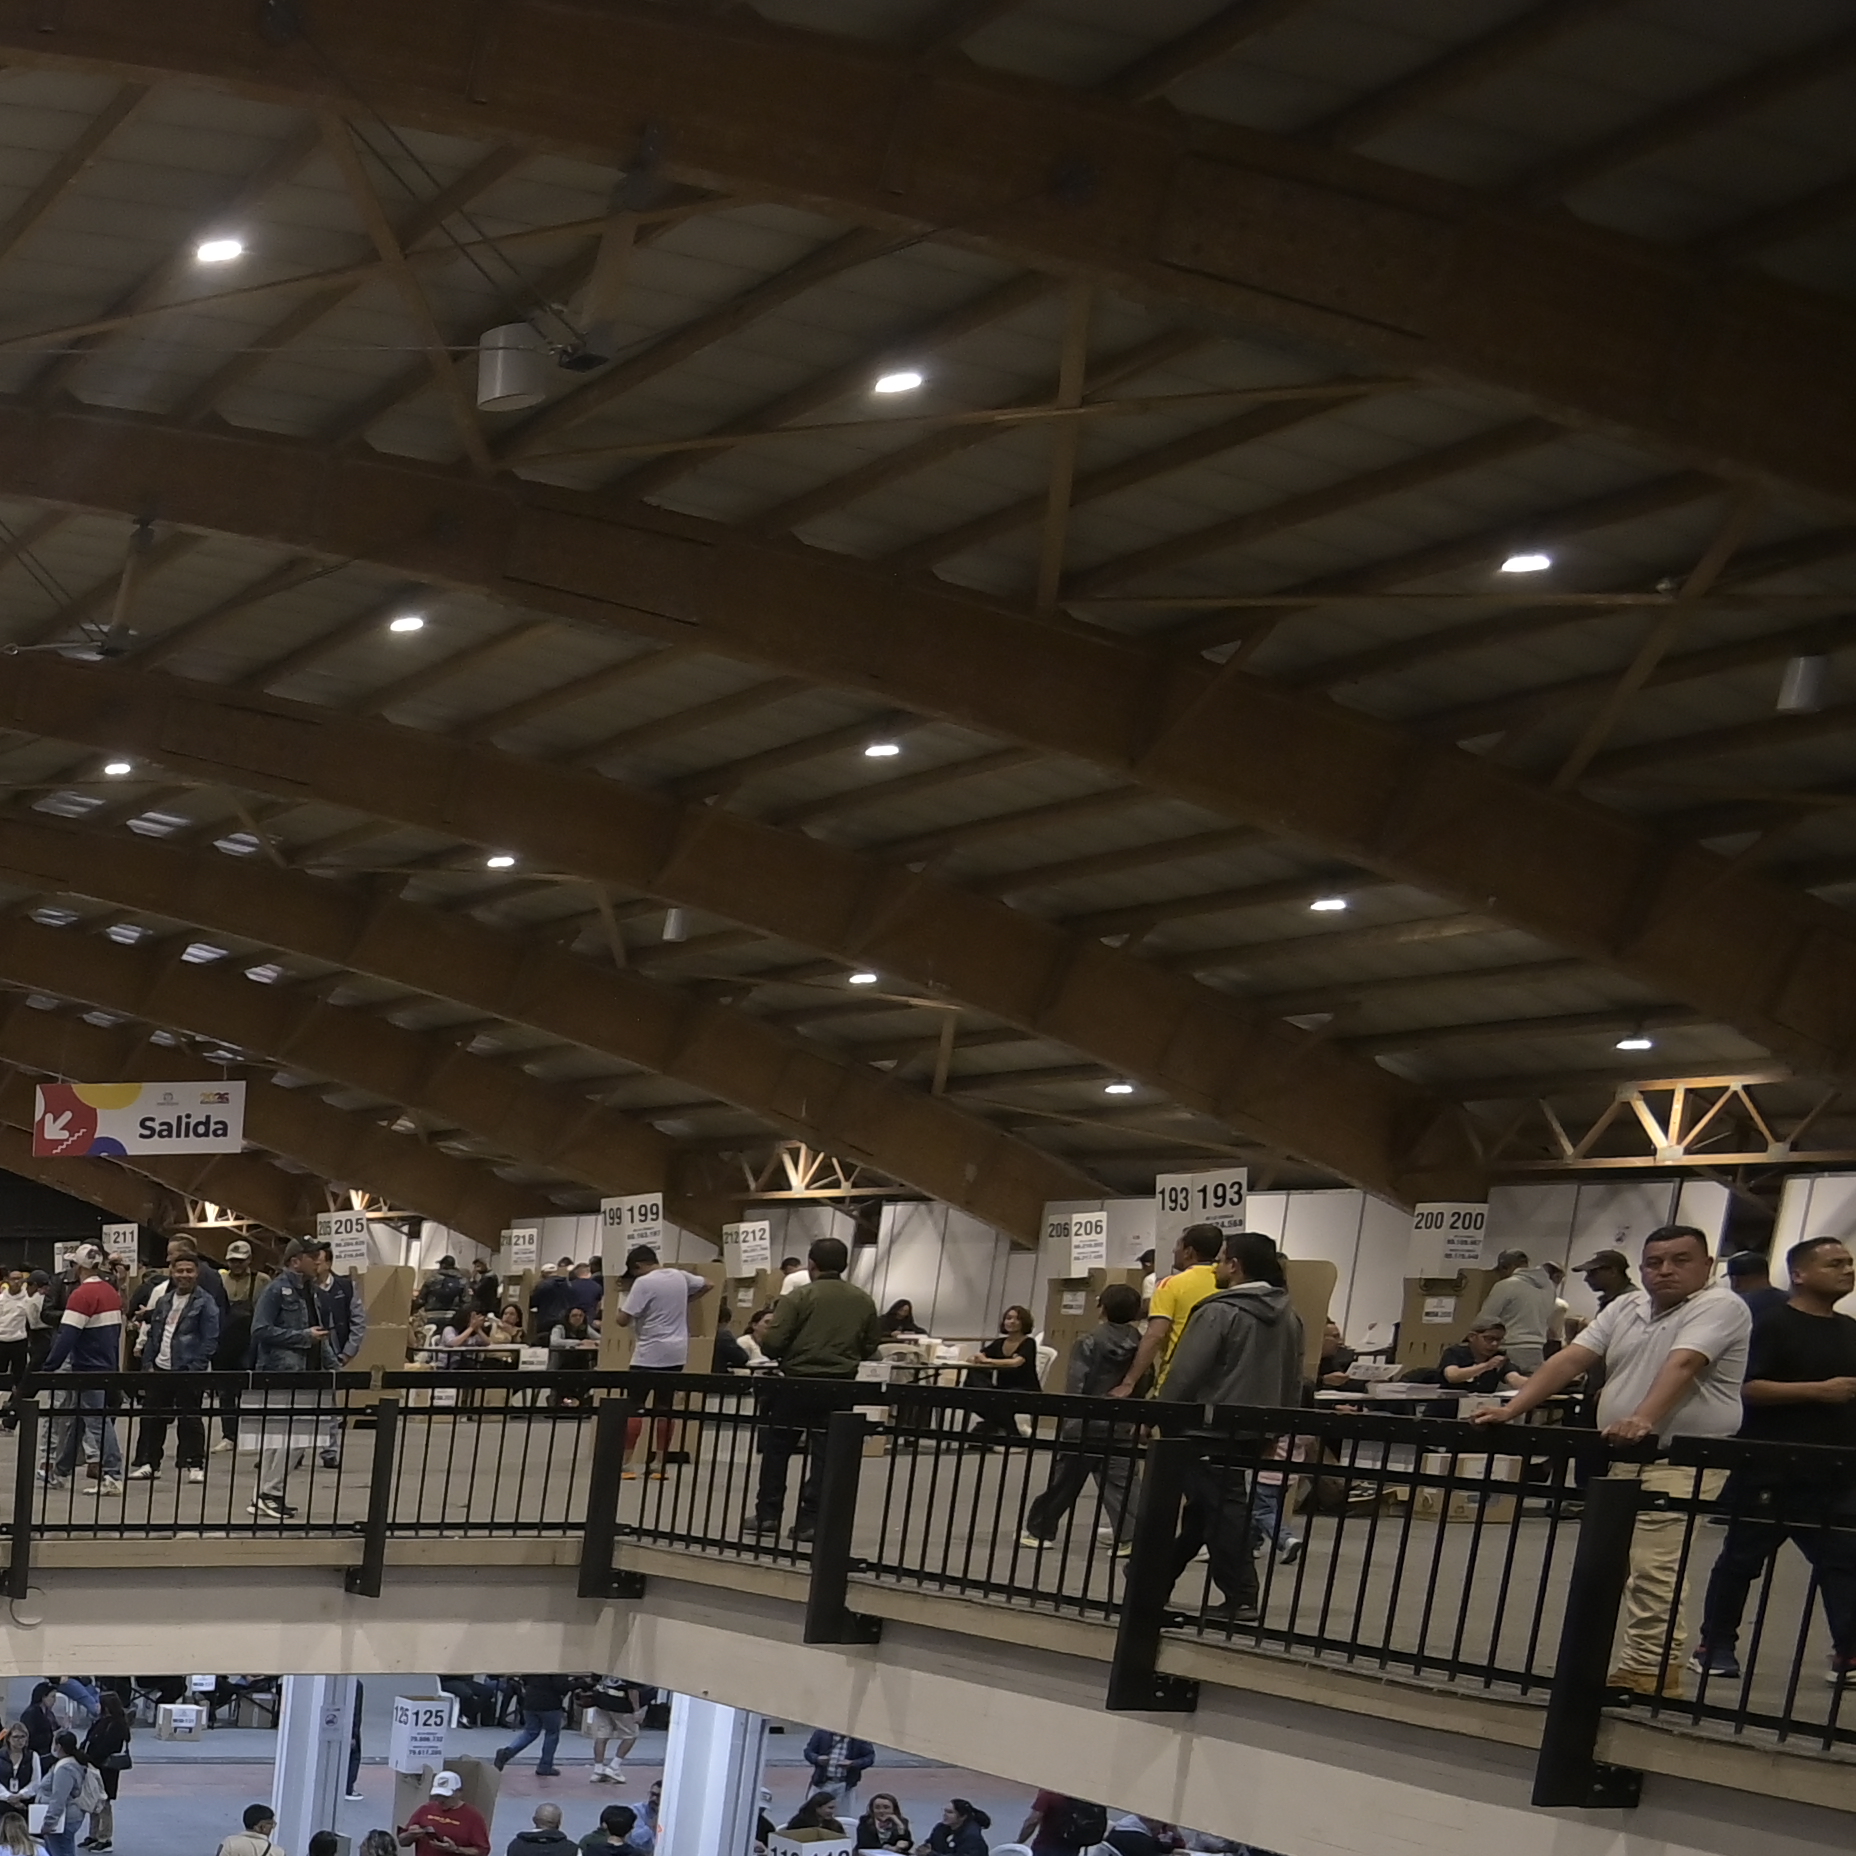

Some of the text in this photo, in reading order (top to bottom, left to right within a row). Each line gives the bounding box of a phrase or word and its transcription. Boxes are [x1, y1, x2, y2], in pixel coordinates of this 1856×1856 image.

[138, 1115, 230, 1140] Salida
[1158, 1187, 1190, 1212] 193
[1197, 1181, 1244, 1210] 193
[602, 1206, 623, 1227] 199
[627, 1202, 661, 1224] 199
[1415, 1211, 1444, 1230] 200
[1449, 1211, 1485, 1230] 200
[334, 1218, 365, 1235] 205
[742, 1227, 767, 1244] 212
[1048, 1222, 1069, 1238] 206
[1074, 1219, 1103, 1236] 206
[112, 1230, 135, 1247] 211
[513, 1233, 535, 1247] 218
[395, 1705, 409, 1726] 125
[412, 1708, 445, 1728] 125
